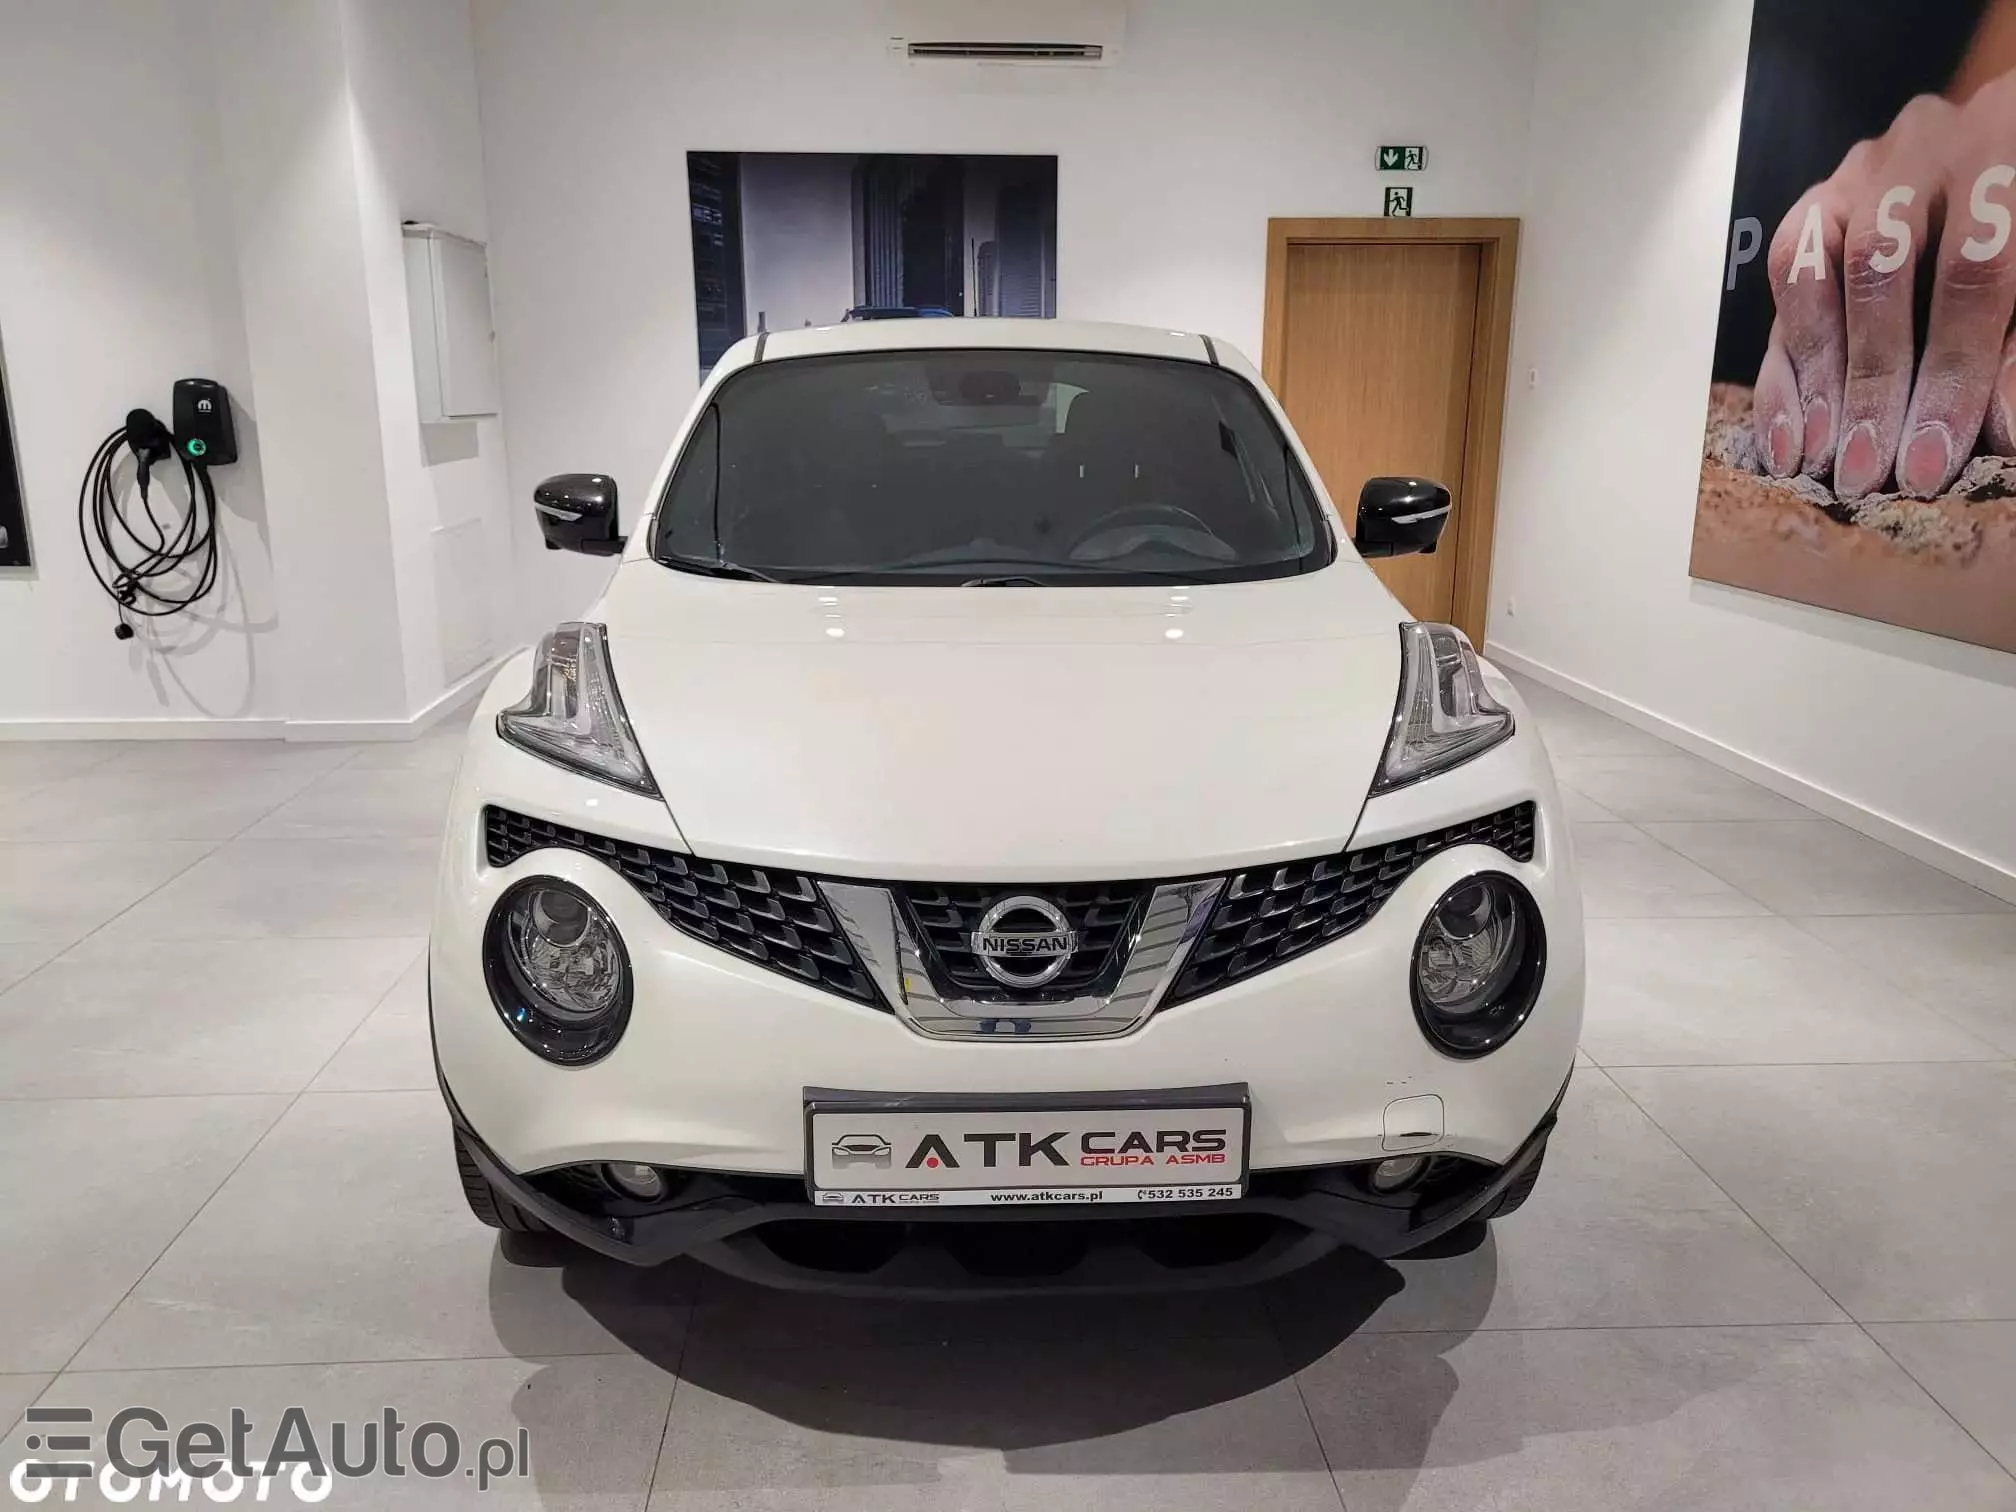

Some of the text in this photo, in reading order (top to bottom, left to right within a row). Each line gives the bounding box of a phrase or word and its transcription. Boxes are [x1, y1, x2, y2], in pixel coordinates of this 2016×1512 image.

[982, 937, 1067, 952] NISSAN
[905, 1129, 1226, 1168] ATK CARS
[1080, 1153, 1226, 1166] GRUPA ASMB
[851, 1187, 1233, 1204] ATK CARS www.atkcars.pl 532 535 245
